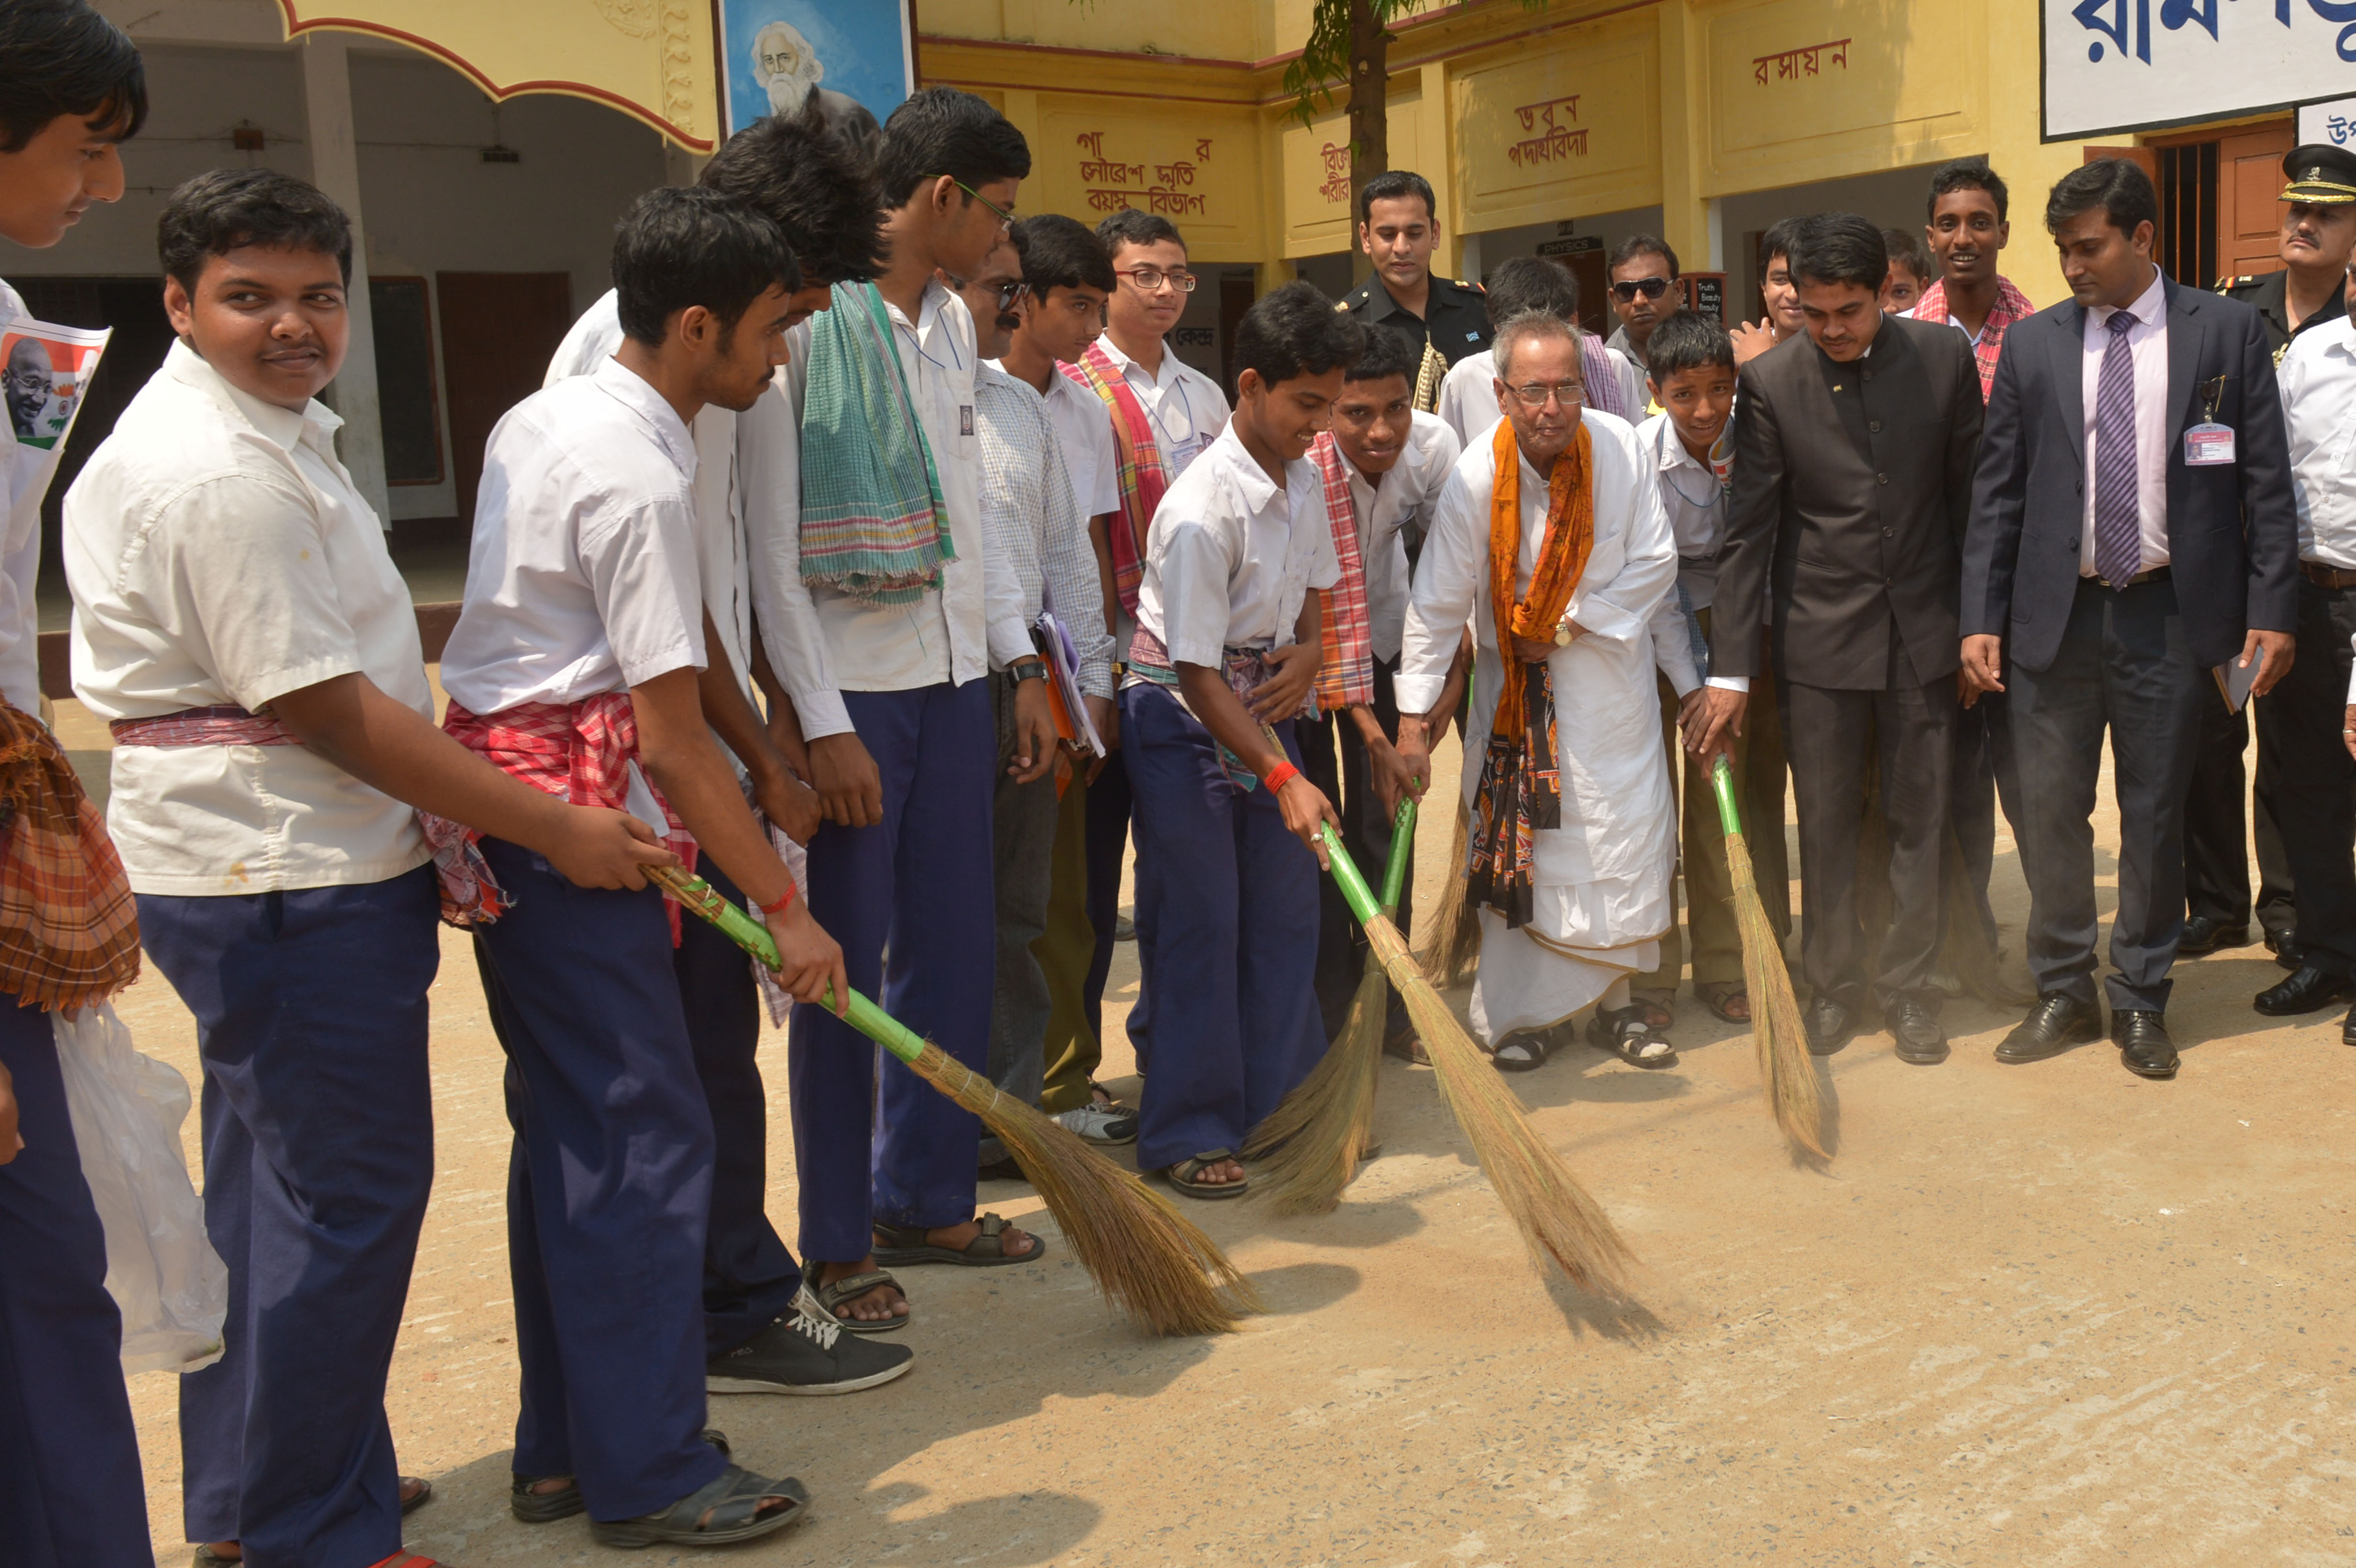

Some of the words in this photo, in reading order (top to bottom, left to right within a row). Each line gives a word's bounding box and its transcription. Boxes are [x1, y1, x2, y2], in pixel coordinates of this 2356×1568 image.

[1752, 38, 1852, 85] রসায়ন
[1514, 94, 1581, 131] ভবন
[1148, 186, 1205, 215] বিভাগ
[1544, 240, 1589, 255] PHYSICS
[1699, 304, 1719, 313] Beauty
[1701, 293, 1721, 303] Beauty
